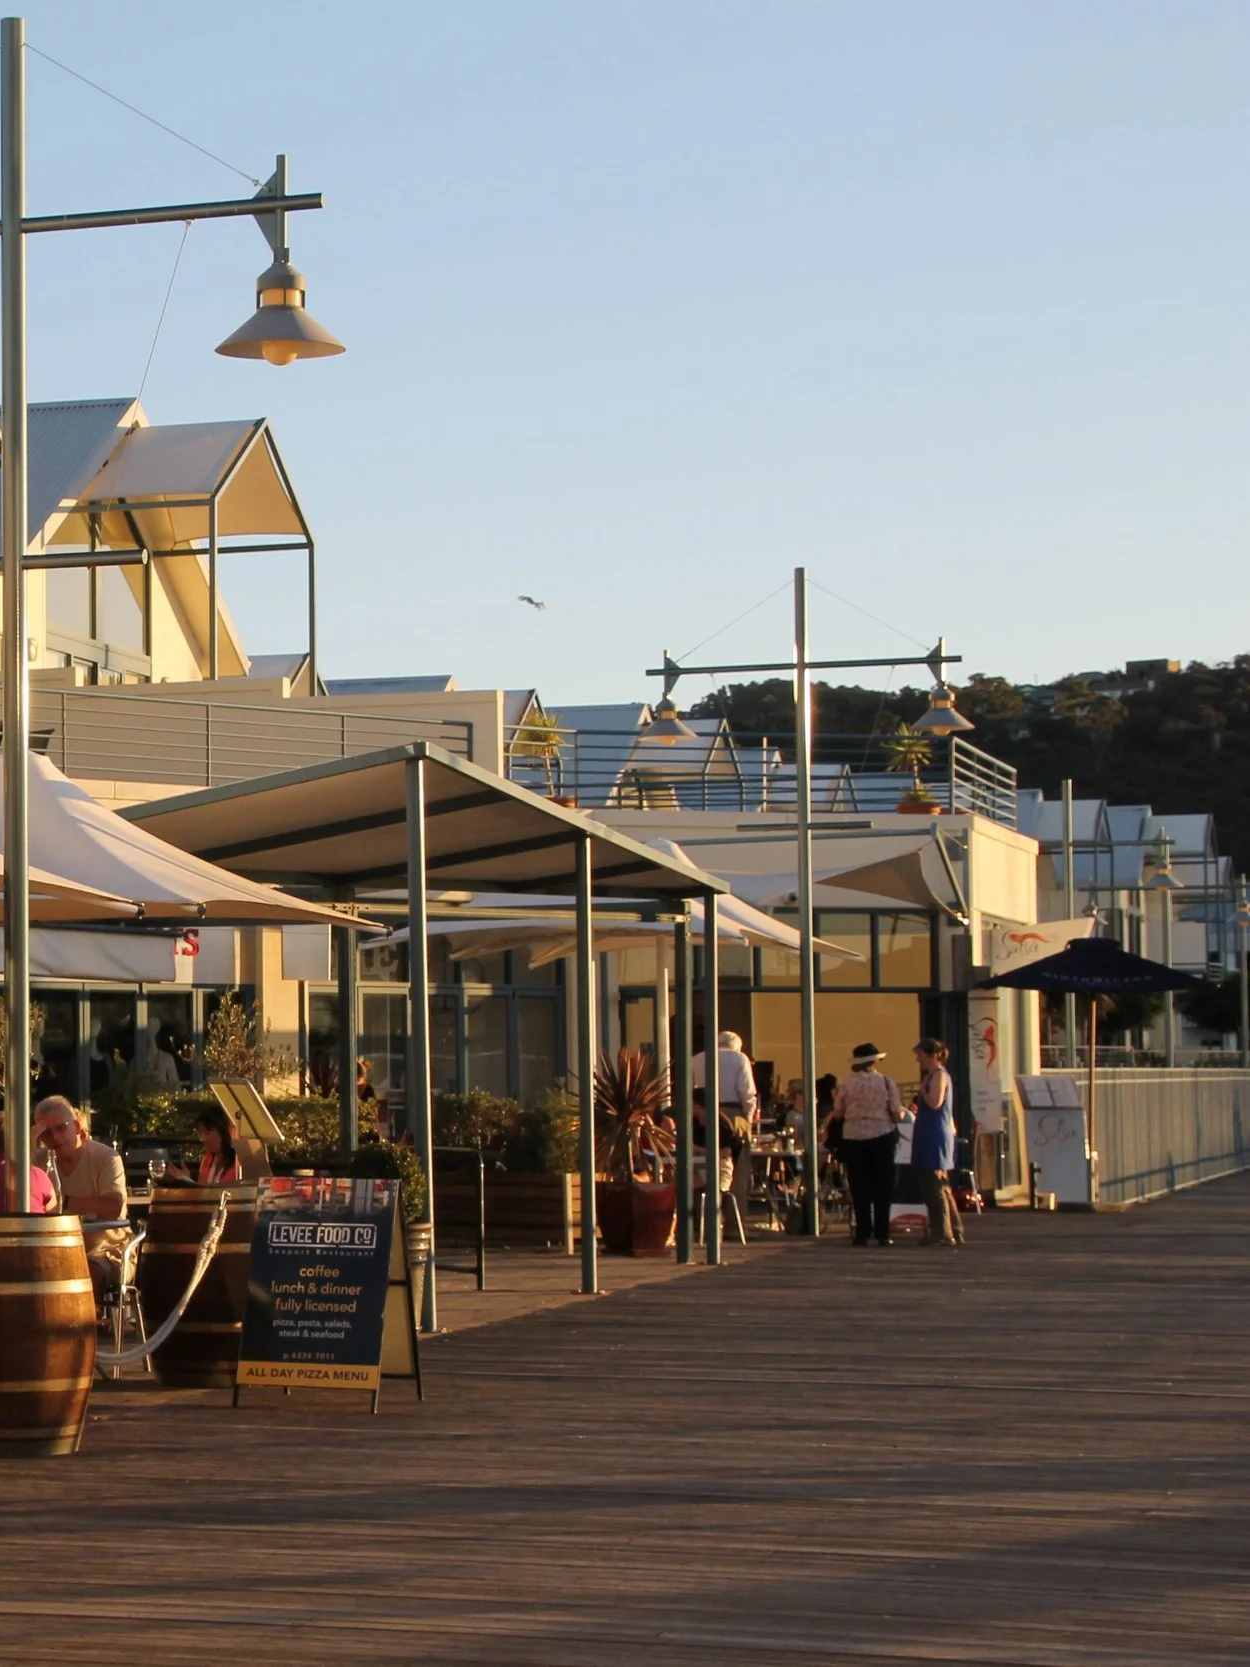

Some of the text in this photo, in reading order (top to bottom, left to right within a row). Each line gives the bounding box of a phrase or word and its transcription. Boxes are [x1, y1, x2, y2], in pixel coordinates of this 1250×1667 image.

[272, 1225, 313, 1243] LEVEE
[316, 1226, 351, 1244] FOOD
[299, 1264, 340, 1278] coffee
[271, 1280, 362, 1296] lunch & dinner
[275, 1297, 357, 1315] fully licensed
[272, 1319, 352, 1329] pizza, pasta, salads,
[278, 1329, 345, 1339] steak & seafood
[246, 1367, 369, 1381] ALL DAY PIZZA MENU
